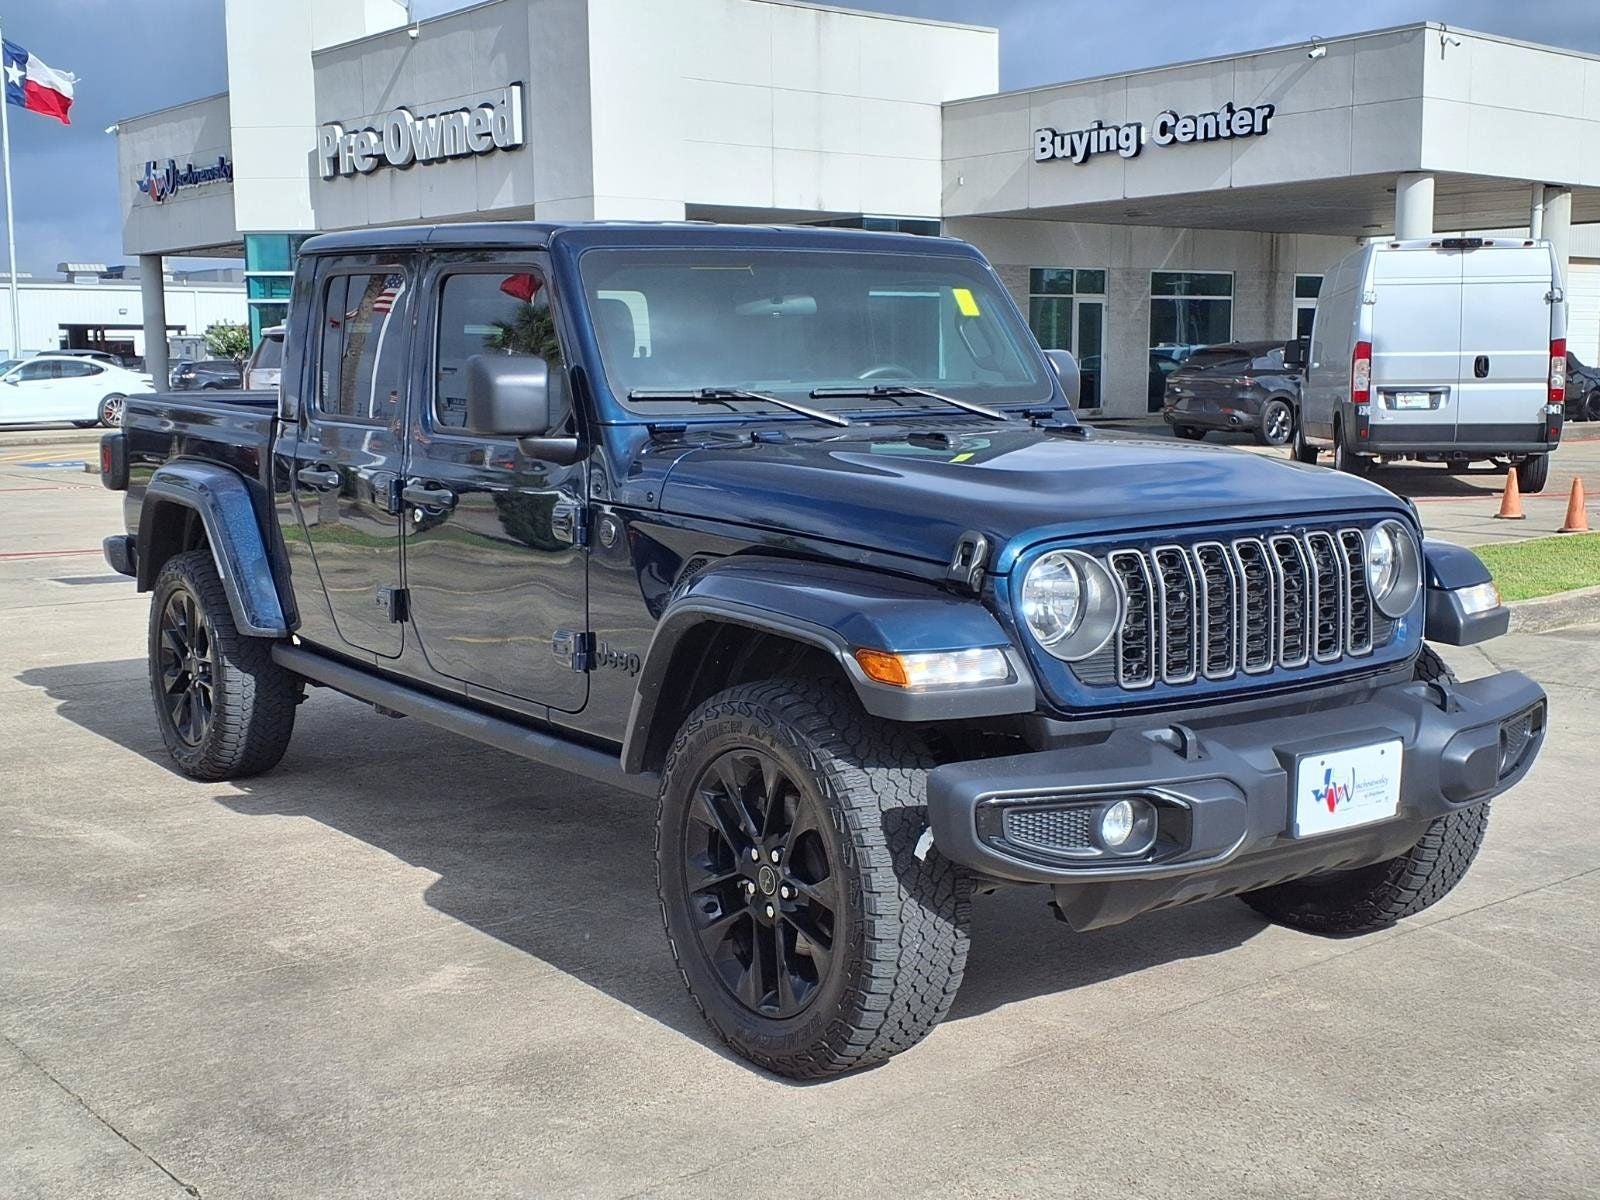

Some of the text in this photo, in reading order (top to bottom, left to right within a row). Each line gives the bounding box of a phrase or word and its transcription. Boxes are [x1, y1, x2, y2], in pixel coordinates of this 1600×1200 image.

[318, 83, 523, 179] Pre-Owned
[1034, 102, 1274, 164] Buying Center
[597, 640, 640, 677] Jeep
